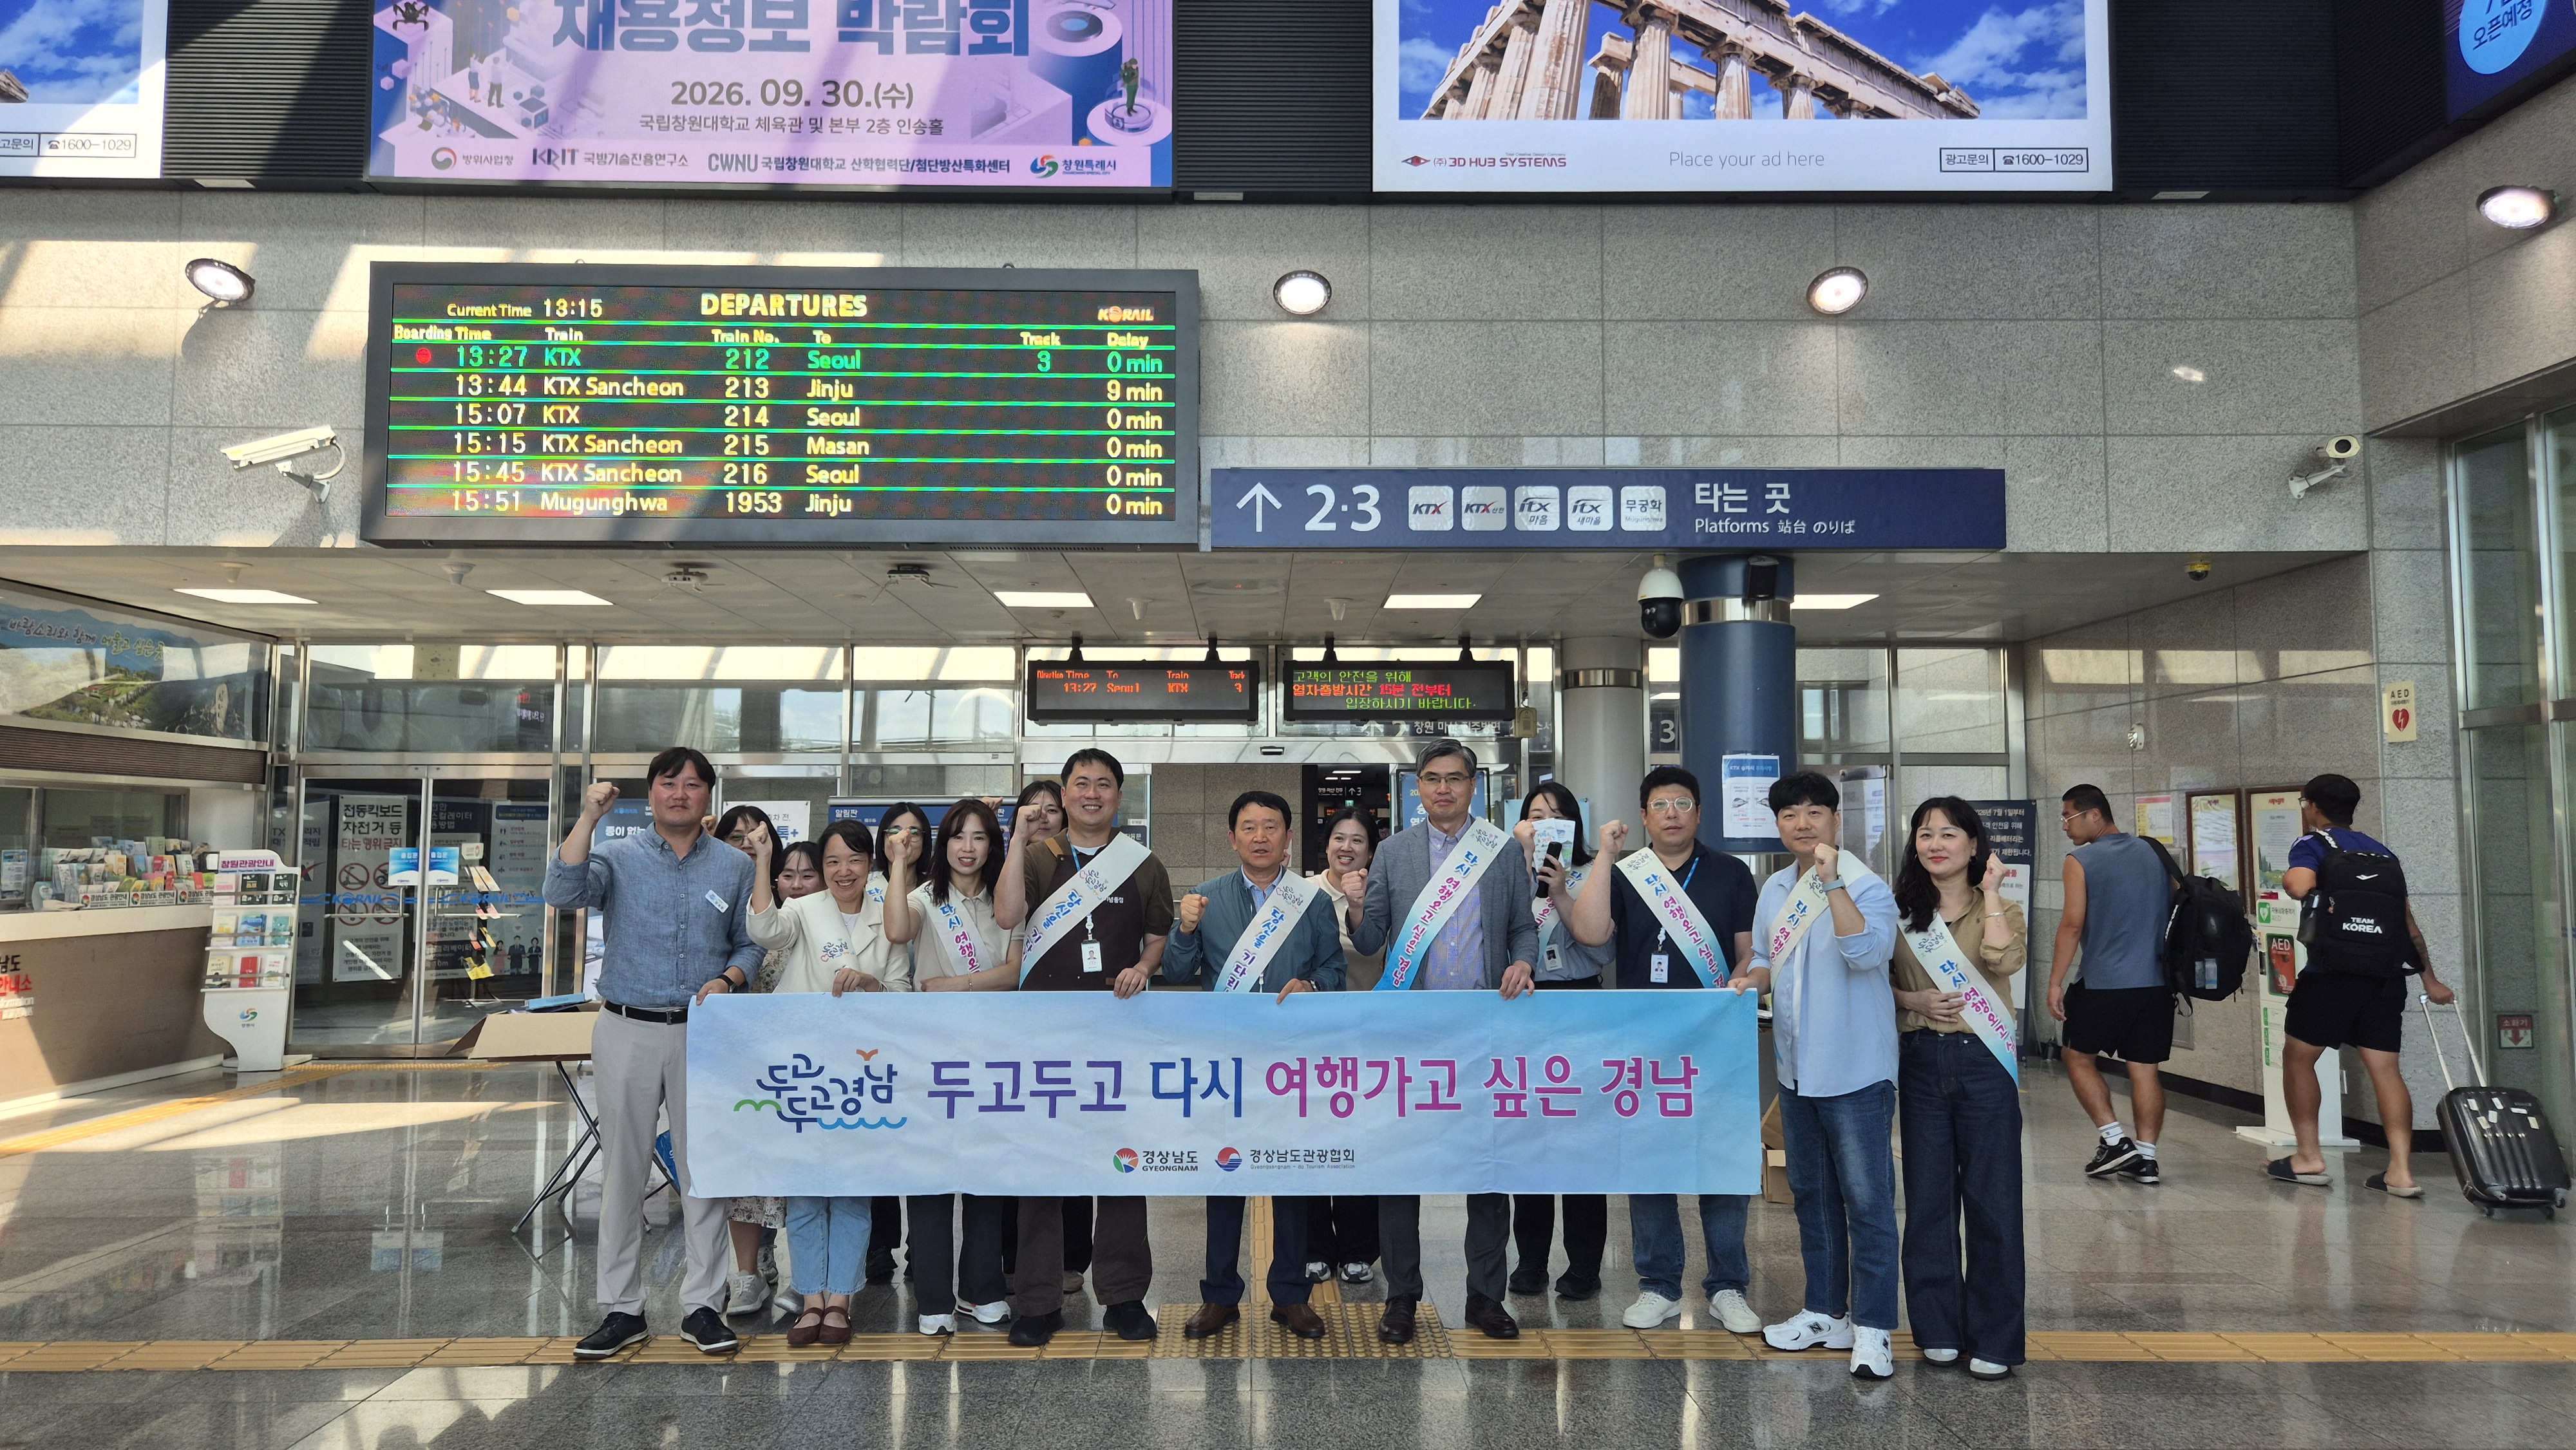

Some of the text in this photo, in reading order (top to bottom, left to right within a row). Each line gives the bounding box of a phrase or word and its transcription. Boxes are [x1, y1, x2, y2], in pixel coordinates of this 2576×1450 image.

[553, 0, 1029, 57] 채용정보 박람회
[2473, 0, 2532, 51] 오픈예정
[671, 79, 914, 109] 2026. 09. 30.(수)
[639, 114, 944, 136] 국립창원대학교 체육관 및 본부 2층 인송홀
[62, 138, 131, 151] 1600-1029
[462, 153, 514, 167] 방위사업청
[532, 147, 578, 172] KRIT
[583, 151, 690, 167] 국방기술진흥연구소
[708, 153, 759, 173] CWNU
[761, 156, 847, 172] 국립창원대학교
[1062, 159, 1116, 171] 창원특례시
[1448, 157, 1466, 167] 3D
[1499, 157, 1567, 167] SYSTEMS
[1669, 152, 1825, 170] Place your ad here
[1945, 153, 1989, 165] 광고문의
[2015, 153, 2084, 166] 1600-1029
[447, 298, 603, 318] Current Time 13:15
[700, 294, 868, 318] DEPARTURES
[1097, 306, 1154, 322] KORAIL
[393, 325, 492, 341] Boarding Time
[545, 327, 584, 342] Train
[711, 328, 780, 344] Train No.
[1020, 332, 1061, 346] Track
[1107, 332, 1150, 350] Delay
[457, 345, 527, 368] 13:27
[544, 347, 582, 367] KTX
[725, 348, 770, 370] 212
[808, 350, 862, 370] Seoul
[1037, 351, 1052, 372] 3
[1106, 351, 1163, 373] 0 min
[455, 373, 528, 397] 13:44
[543, 376, 684, 397] KTX Sancheon
[724, 377, 770, 399] 213
[806, 379, 854, 403] Jinju
[1106, 379, 1163, 402] 9 min
[455, 402, 526, 425] 15:07
[724, 405, 770, 428] 214
[806, 407, 860, 427] Seoul
[454, 432, 527, 455] 15:15
[584, 433, 683, 454] Sancheon
[724, 434, 770, 456] 215
[806, 437, 869, 455] Masan
[453, 460, 526, 484] 15:45
[583, 462, 683, 483] Sancheon
[723, 462, 768, 485] 216
[806, 464, 860, 484] Seoul
[453, 490, 521, 513] 15:51
[540, 491, 668, 516] Mugunghwa
[725, 491, 782, 514] 1953
[804, 494, 852, 516] Jinju
[1519, 497, 1553, 513] itx
[1571, 499, 1602, 514] itx
[1625, 499, 1663, 513] 무궁화
[1694, 482, 1791, 514] 타는 곳
[1412, 500, 1446, 515] KTX
[1464, 500, 1497, 514] KTX
[1528, 515, 1548, 525] 마음
[1577, 516, 1601, 526] 새마을
[1694, 518, 1770, 534] Platforms
[1777, 519, 1807, 534] 站台
[1066, 670, 1090, 679] Time
[1167, 671, 1189, 679] Train
[1293, 671, 1412, 683] 고객의 안전을 위해
[1063, 683, 1097, 693] 13:27
[1106, 683, 1141, 693] Seoul
[1168, 683, 1189, 693] KTX
[1293, 684, 1452, 697] 열차출발시간 15분 전부터
[2391, 689, 2409, 699] AED
[1345, 697, 1476, 710] 입장하시기 바랍니다.
[1414, 720, 1434, 734] 창원
[1660, 719, 1676, 744] 3
[344, 804, 402, 818] 전동킥보드
[835, 809, 858, 818] 알림판
[1993, 808, 2025, 816] 7월 1일부터
[343, 822, 402, 835] 자전거 등
[605, 826, 625, 837] 종이
[1992, 822, 2009, 830] 안전을
[341, 838, 381, 851] 타는 행위
[221, 859, 275, 869] 창원관광안내
[1565, 869, 1584, 890] 다시
[333, 892, 383, 905] KORAIL
[940, 903, 961, 929] 다시
[1393, 849, 1479, 988] 다시 여행오고 싶은 경남
[1787, 899, 1808, 928] 다시
[1643, 873, 1719, 974] 다시 여행오고 싶은
[2342, 922, 2383, 934] KOREA
[1224, 907, 1286, 992] 당신을 기다리
[2271, 937, 2291, 951] AED
[1938, 959, 2009, 1040] 다시 여행오고
[2501, 1019, 2528, 1027] 소화기
[927, 1054, 1700, 1120] 두고두고 다시 여행가고 싶은 경남
[1142, 1150, 1198, 1164] 경상남도
[1249, 1148, 1355, 1163] 경상남도관광협회
